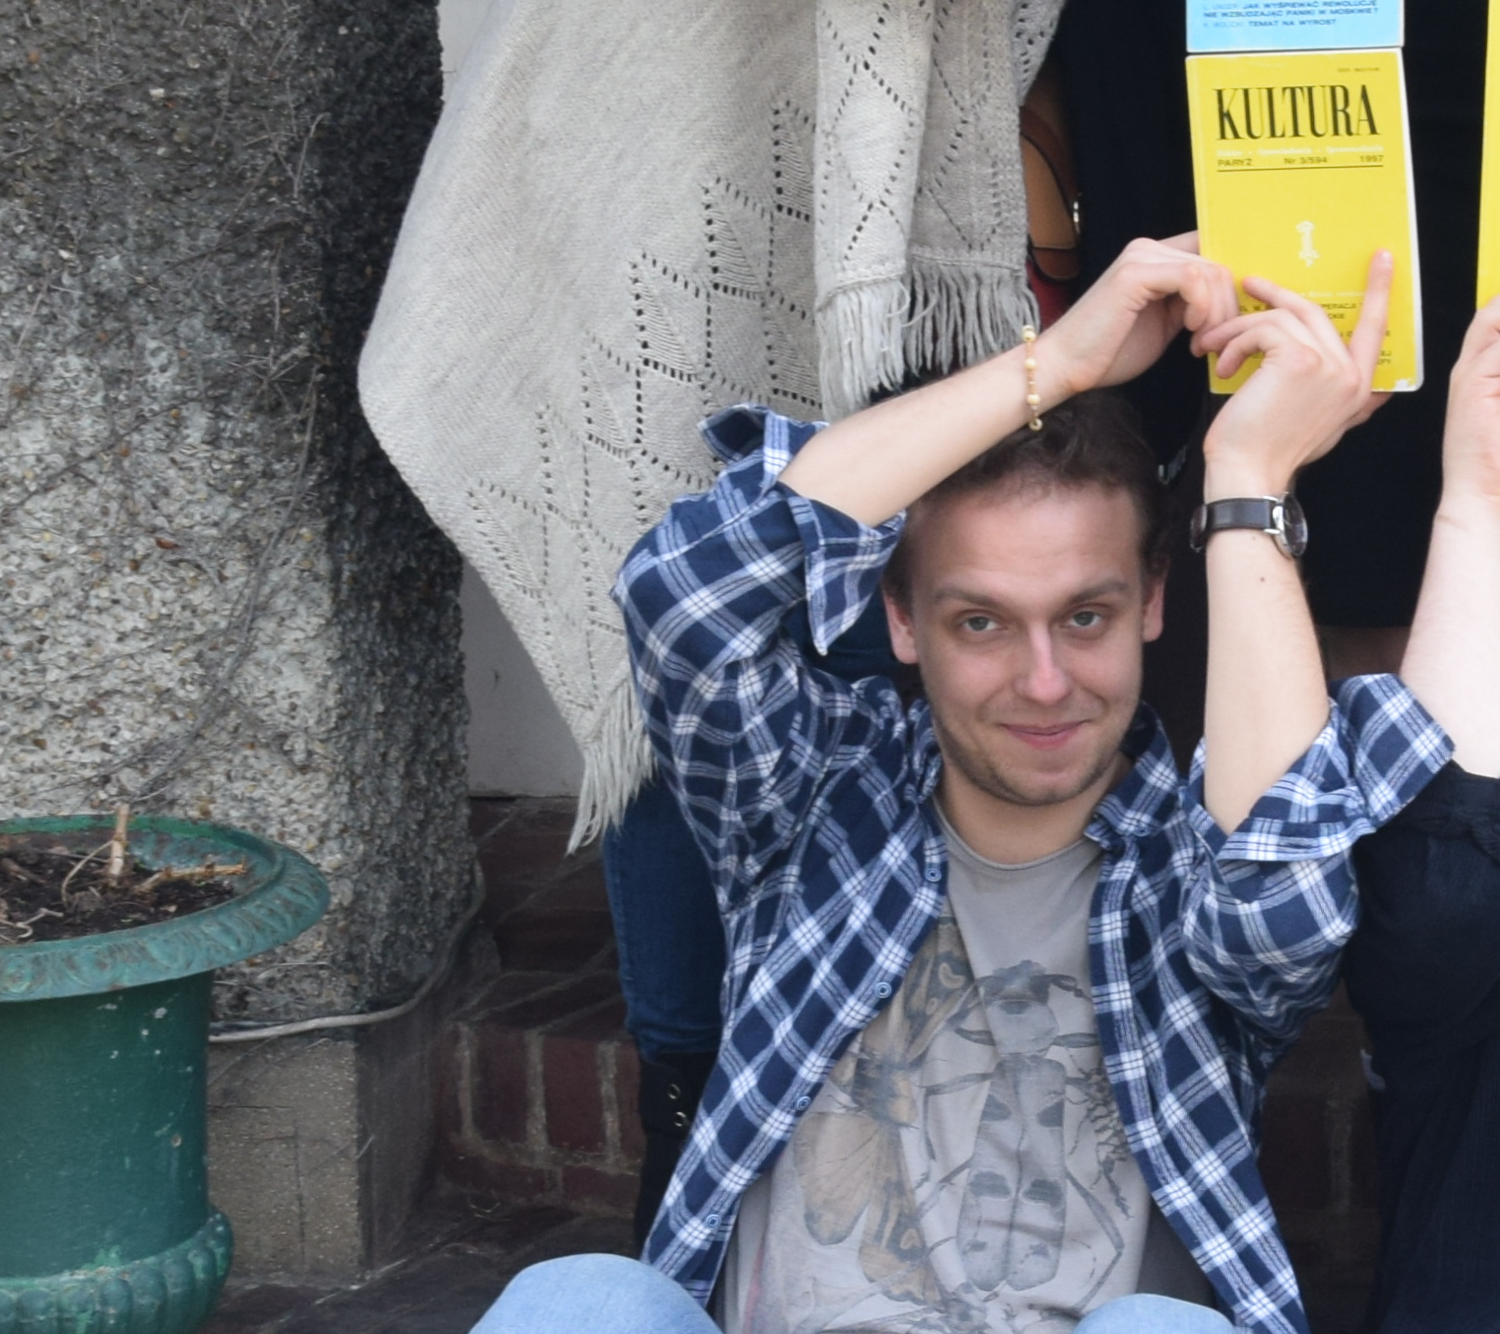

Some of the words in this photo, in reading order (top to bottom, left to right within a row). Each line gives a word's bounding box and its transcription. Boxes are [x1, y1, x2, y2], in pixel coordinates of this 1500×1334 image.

[1213, 84, 1382, 141] KULTURA
[1218, 157, 1253, 167] PARYŻ
[1284, 157, 1295, 165] Nr
